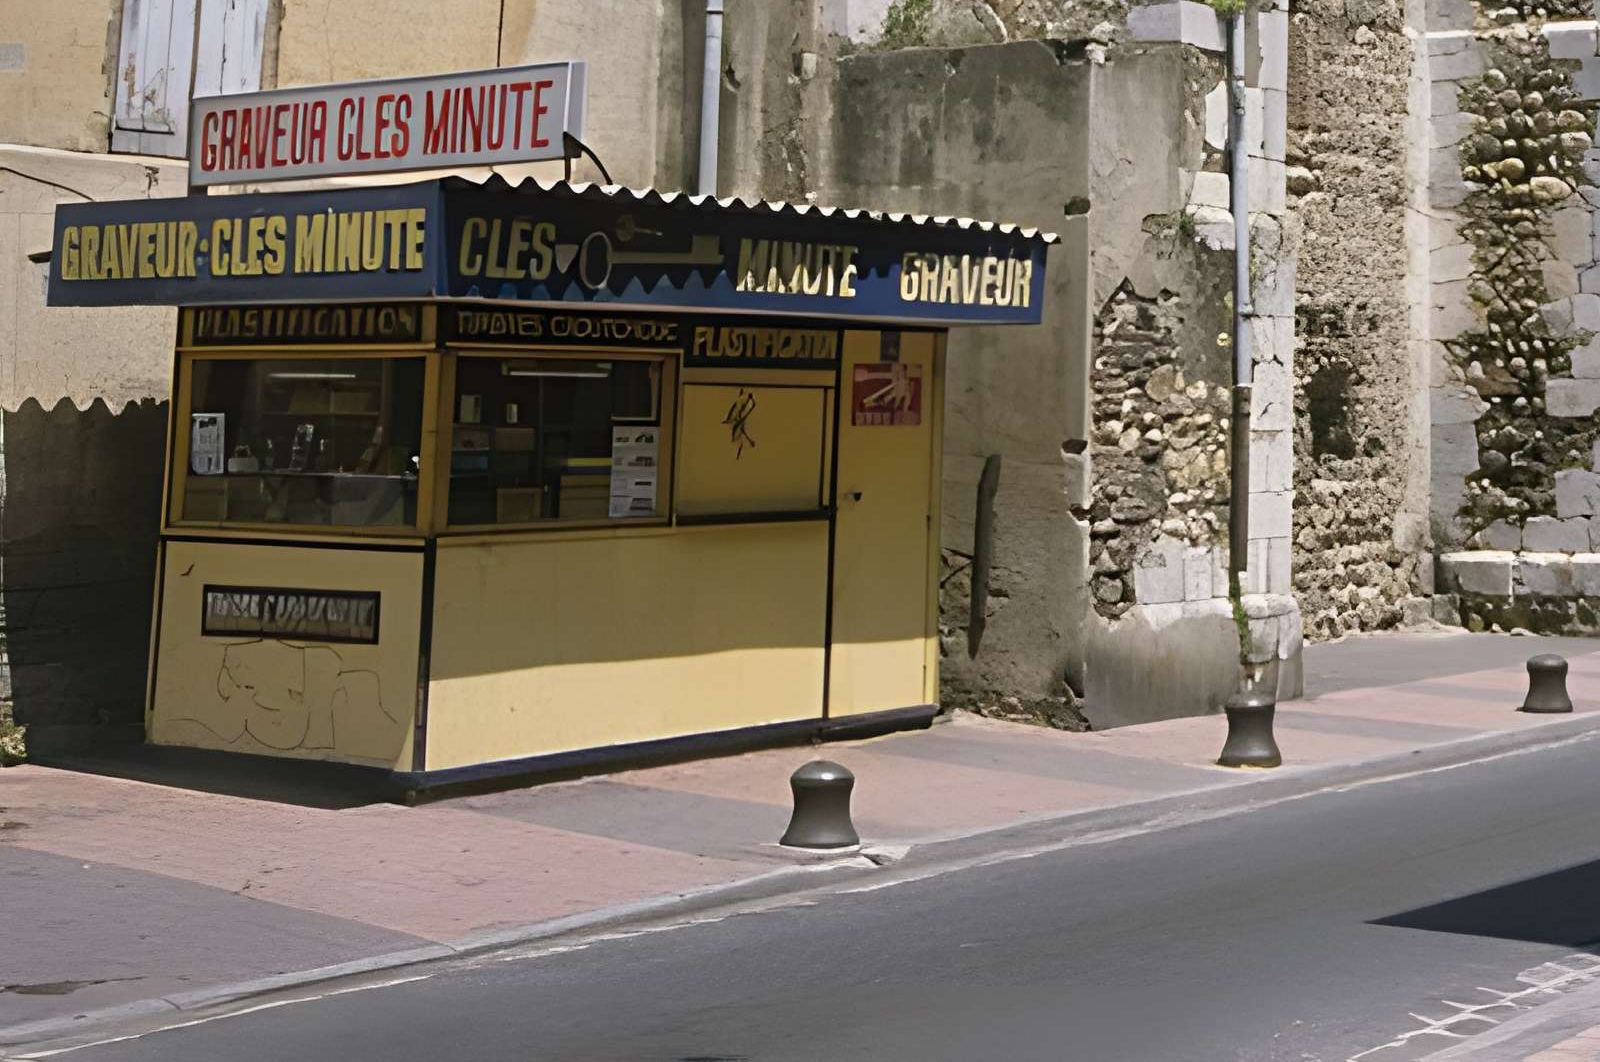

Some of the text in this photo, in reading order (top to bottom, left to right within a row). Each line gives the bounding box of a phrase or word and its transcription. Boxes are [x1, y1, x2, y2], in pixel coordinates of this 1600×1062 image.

[201, 80, 554, 173] GRAVEUR CLES MINUTE
[294, 207, 426, 274] MINUTE
[458, 216, 1033, 308] CLES MINUTE GRAVEUR
